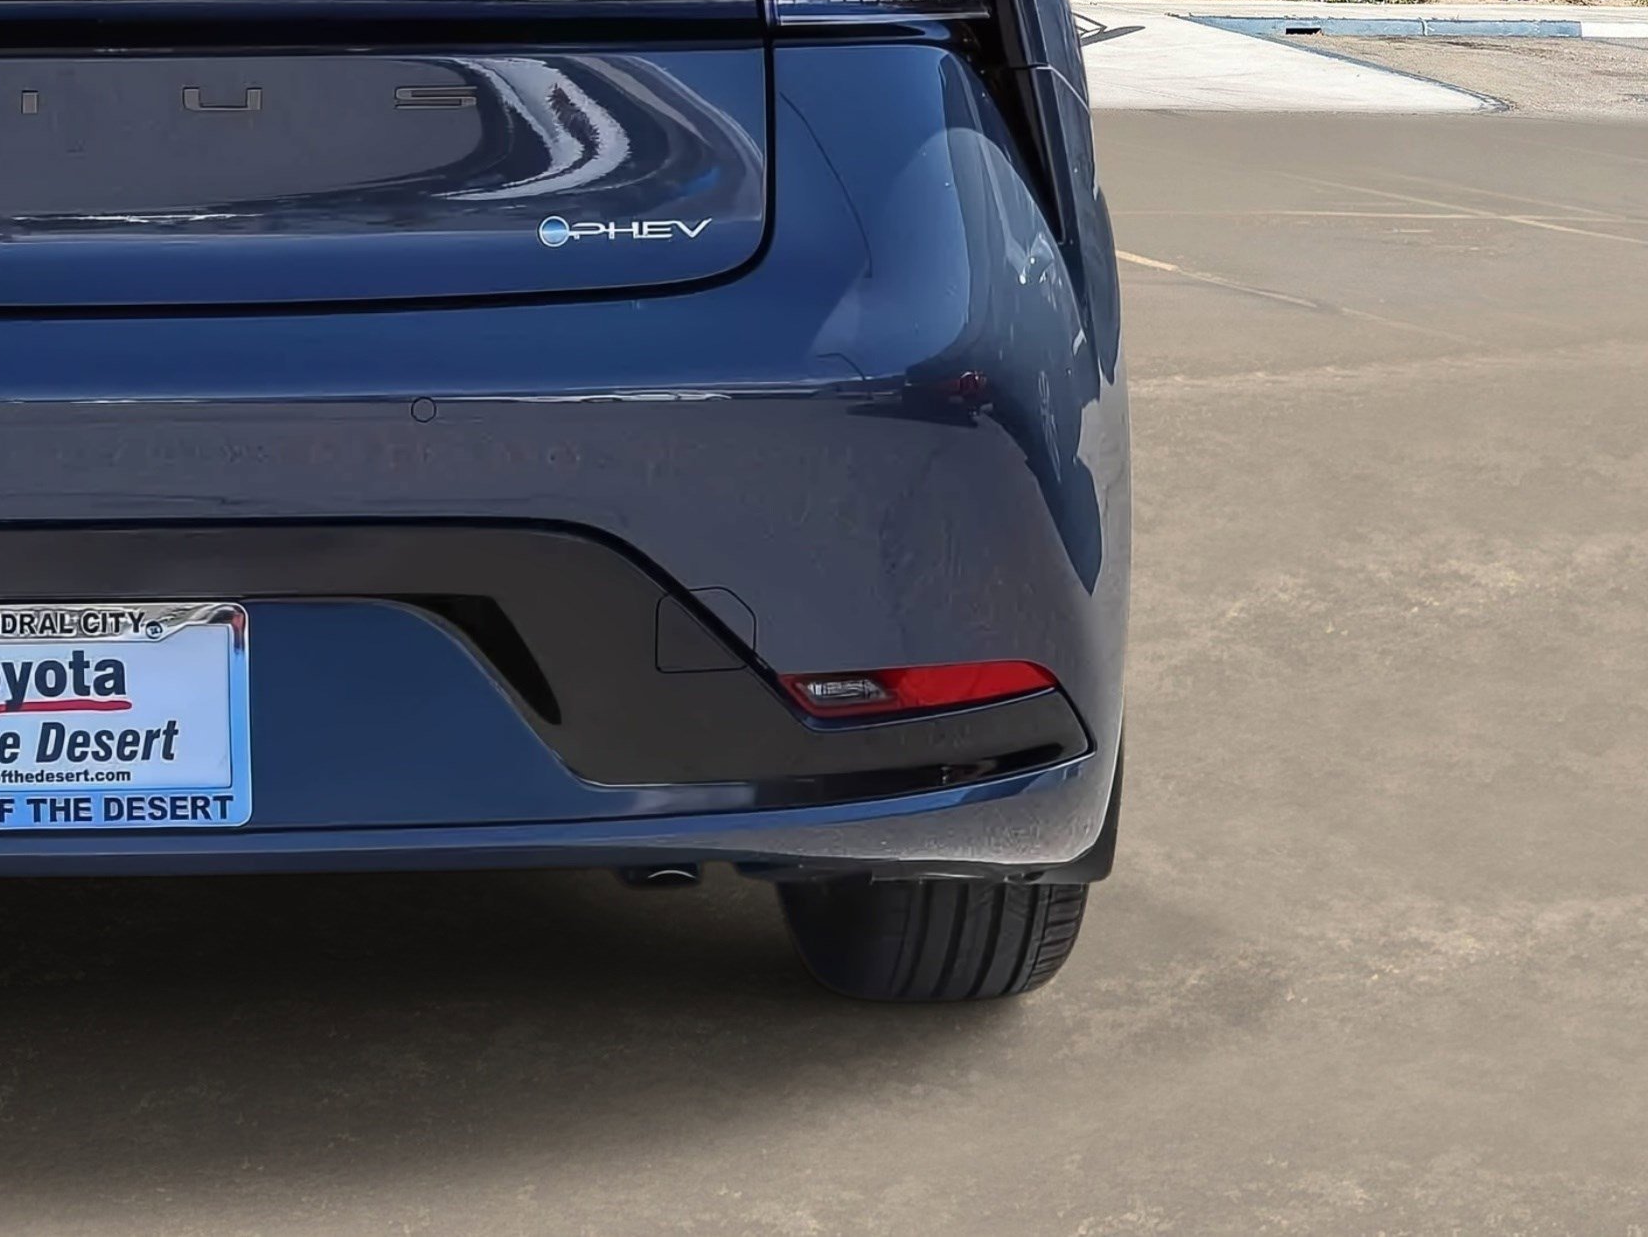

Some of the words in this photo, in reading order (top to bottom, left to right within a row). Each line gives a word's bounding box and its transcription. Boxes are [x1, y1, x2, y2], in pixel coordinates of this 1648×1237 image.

[80, 612, 145, 635] CITY
[36, 720, 179, 764] Desert
[27, 797, 93, 823] THE
[103, 795, 235, 822] DESERT
